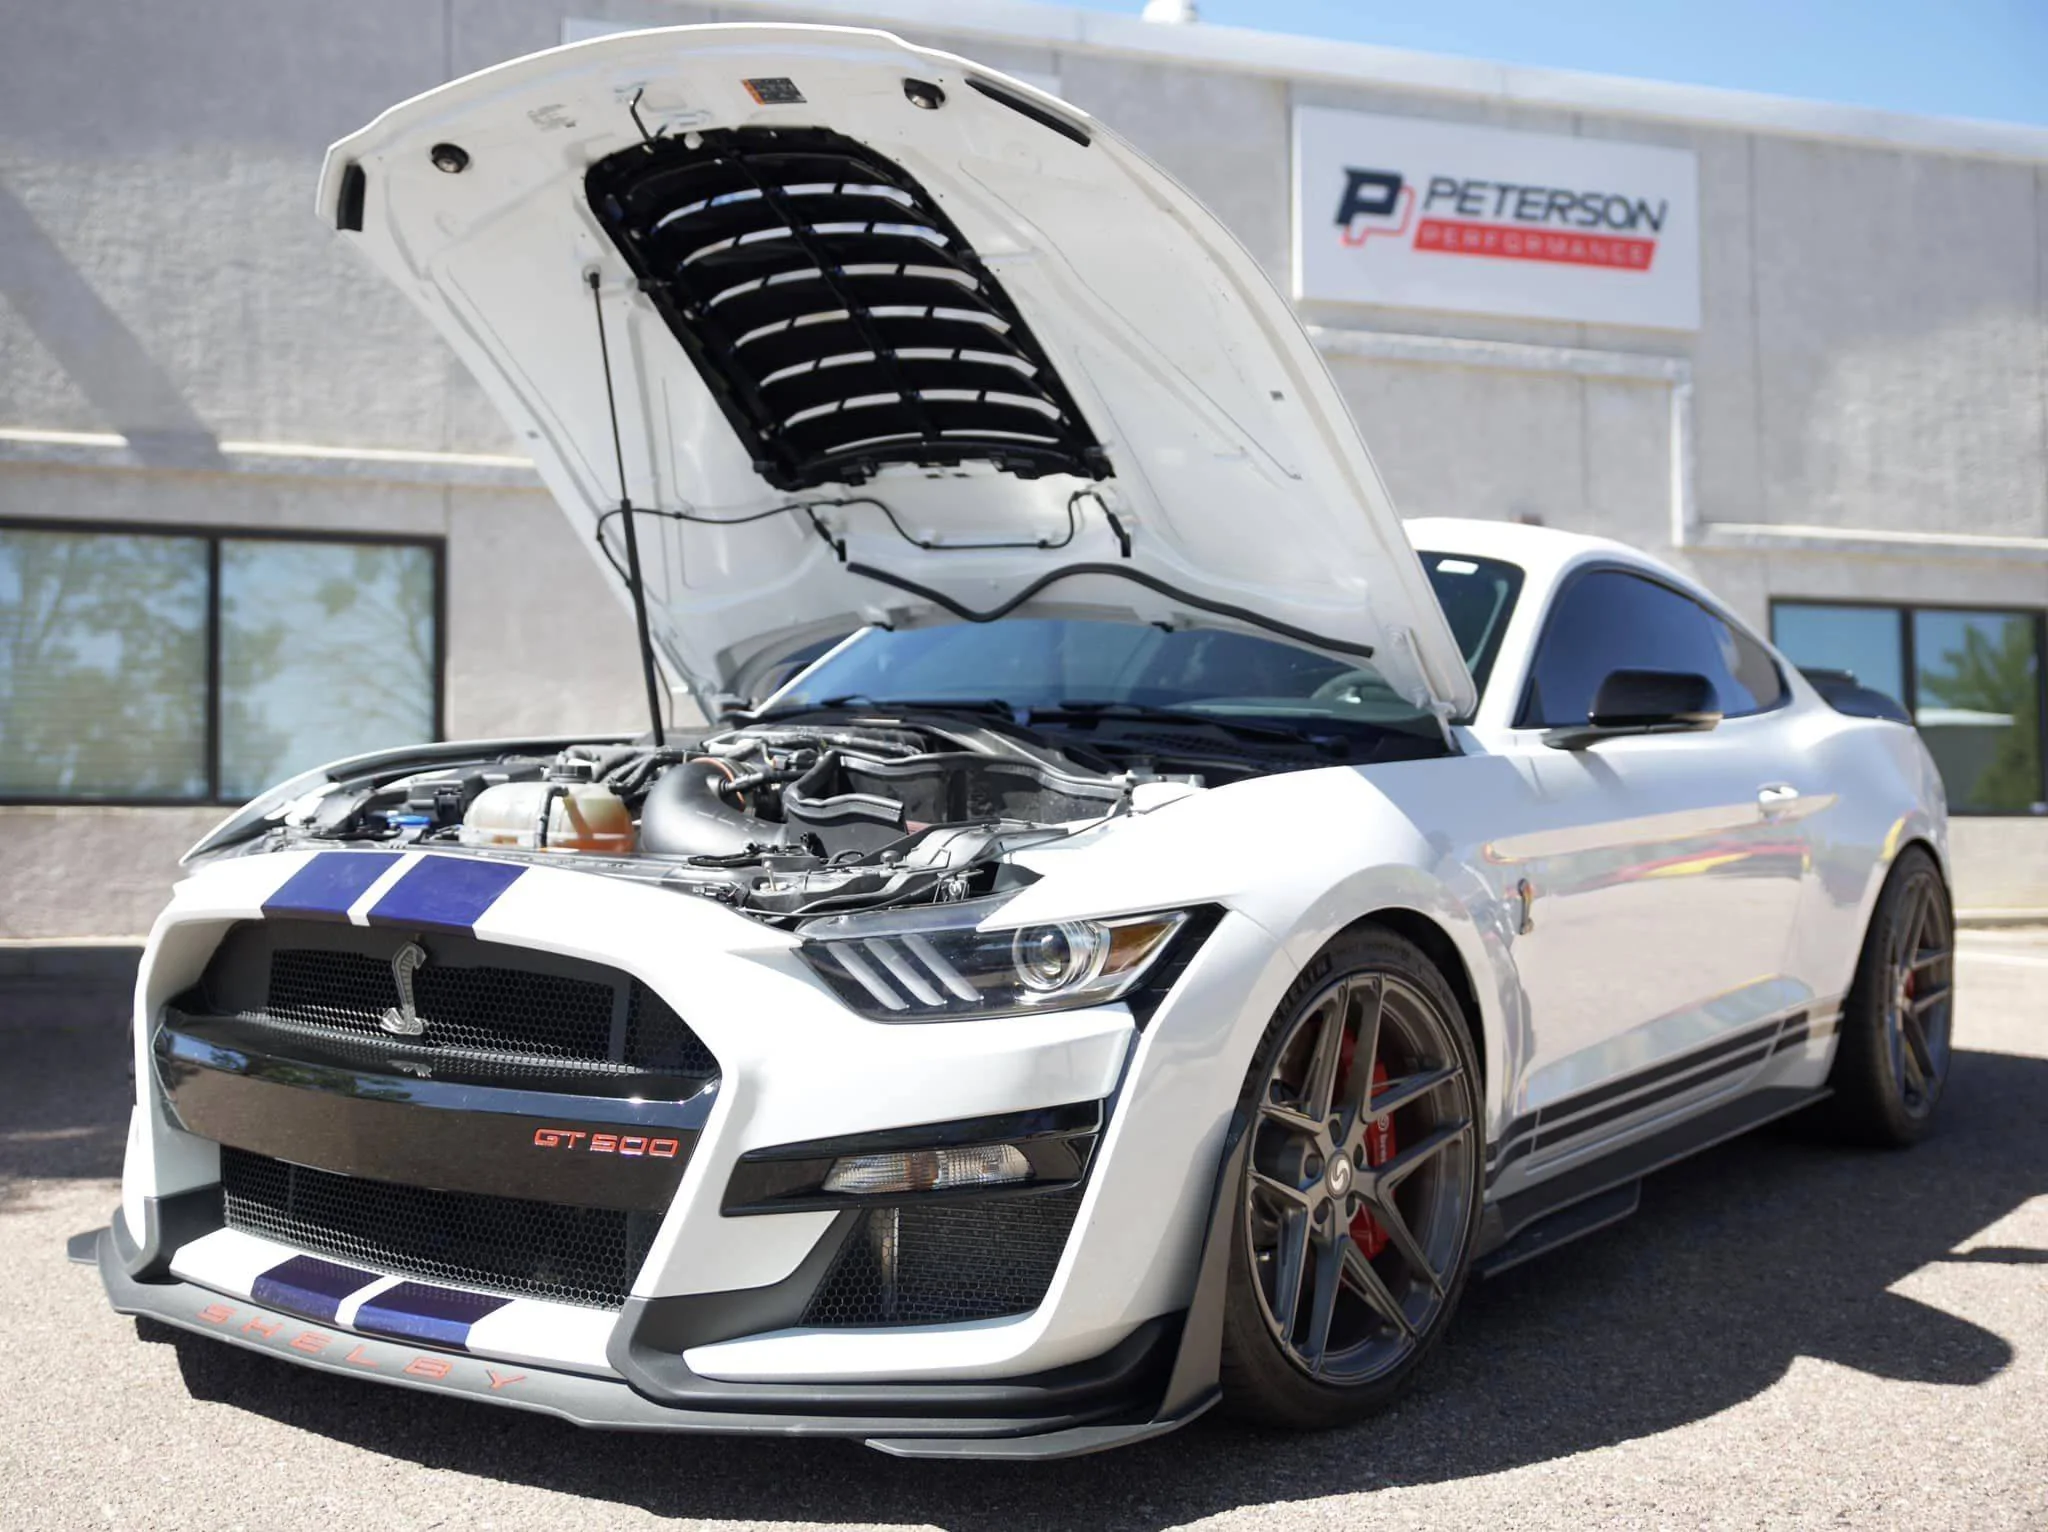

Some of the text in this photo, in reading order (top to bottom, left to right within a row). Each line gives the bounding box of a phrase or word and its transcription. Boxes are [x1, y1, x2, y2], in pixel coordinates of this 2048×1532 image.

[1422, 176, 1669, 232] PETERSON
[1420, 223, 1645, 261] PERFORMANCE
[534, 1128, 680, 1158] GT 500
[197, 1303, 528, 1390] SHELBY
